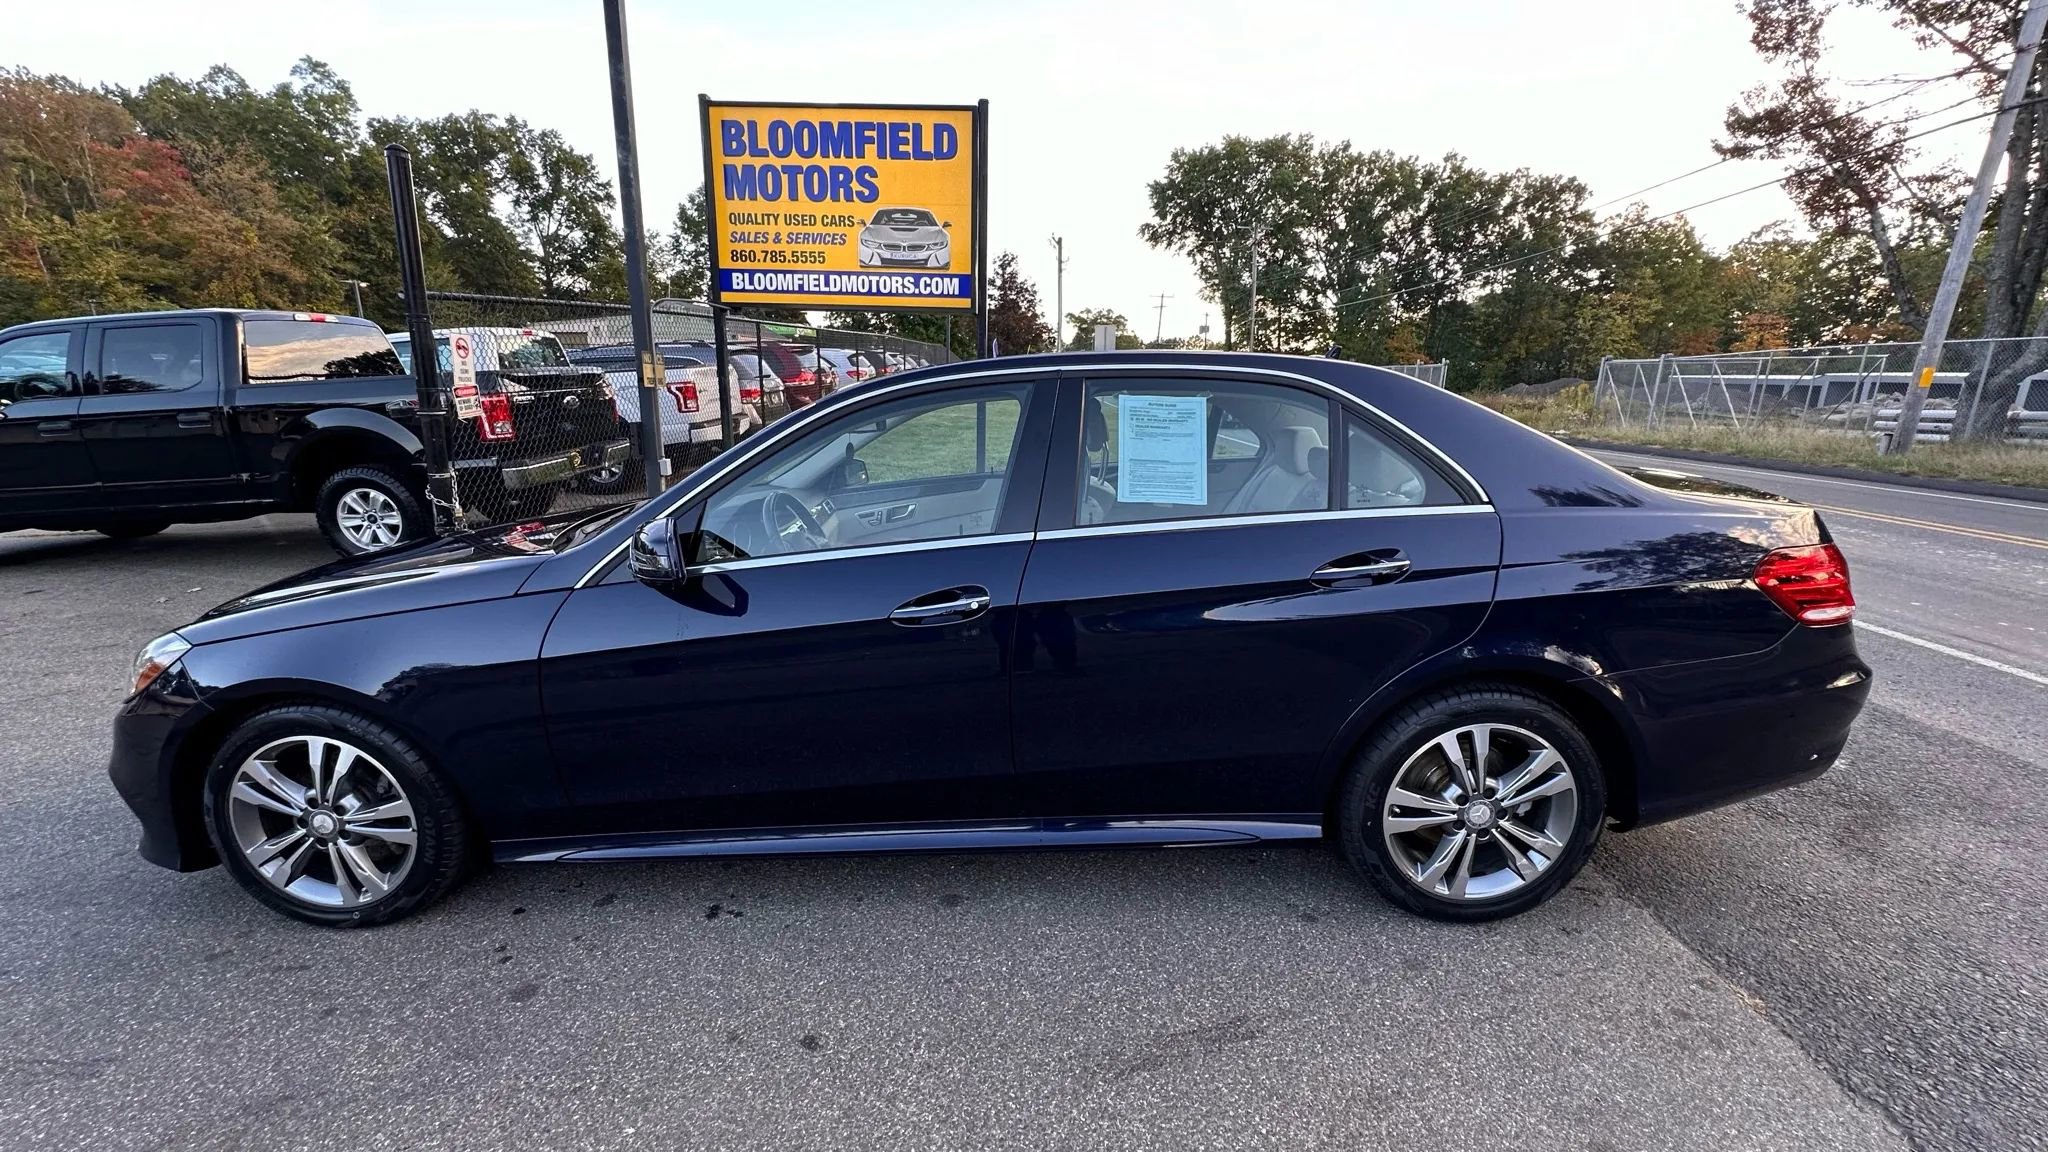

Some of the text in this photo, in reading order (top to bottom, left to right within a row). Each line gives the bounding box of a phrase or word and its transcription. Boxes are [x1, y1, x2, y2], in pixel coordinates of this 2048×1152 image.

[721, 119, 958, 161] BLOOMFIELD
[722, 163, 879, 203] MOTORS
[728, 212, 855, 228] QUALITY USED CARS
[730, 231, 848, 246] SALES & SERVICES
[730, 249, 826, 265] 860.785.5555
[731, 272, 960, 295] BLOOMFIELDMOTORS.COM
